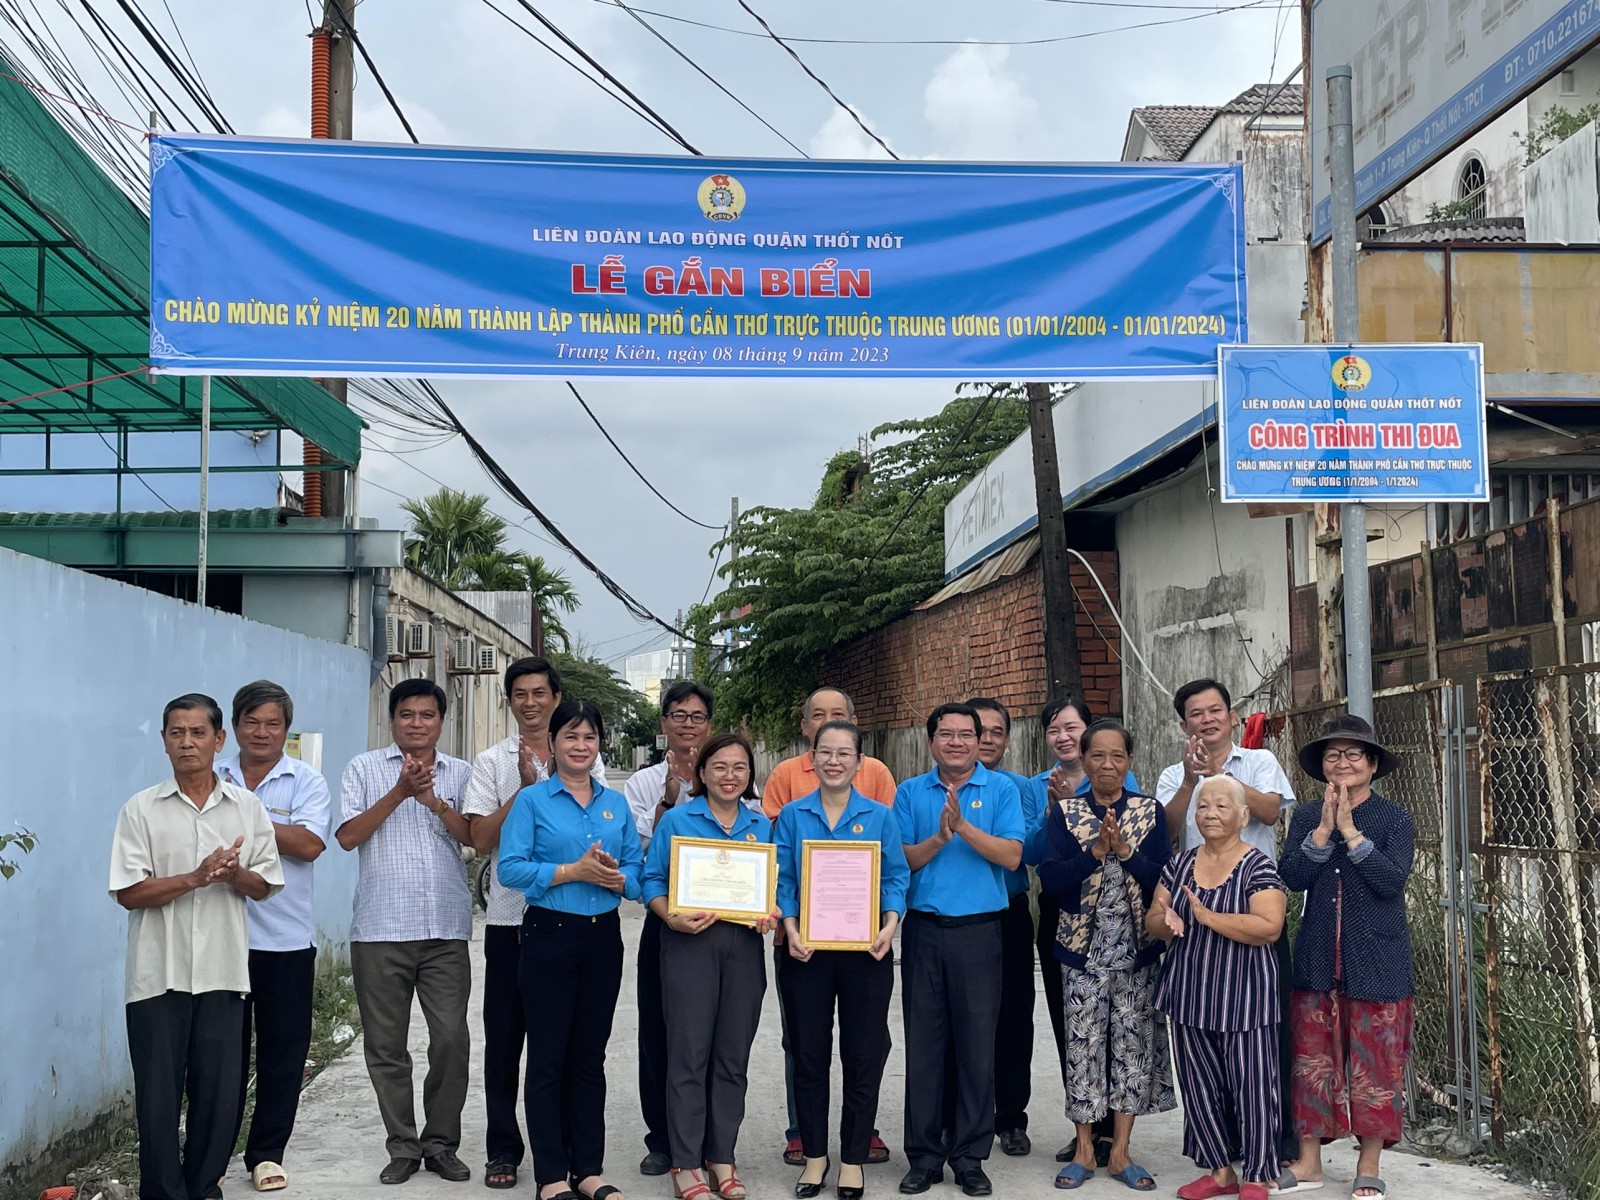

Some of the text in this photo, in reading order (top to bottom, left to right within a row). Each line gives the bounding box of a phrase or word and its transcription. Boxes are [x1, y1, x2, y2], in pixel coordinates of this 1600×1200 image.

[1504, 56, 1525, 84] ĐT:
[533, 226, 904, 250] LIÊN ĐOÀN LAO ĐỘNG QUẬN THỐT NỐT
[571, 254, 872, 298] LỄ GẮN BIỂN
[164, 296, 221, 324] CHÀO
[227, 298, 289, 326] MỪNG
[295, 297, 321, 326] KỶ
[327, 301, 380, 332] NIỆM
[386, 306, 410, 328] 20
[416, 303, 462, 329] NĂM
[468, 306, 532, 331] THÀNH
[537, 307, 573, 337] LẬP
[578, 308, 641, 335] THÀNH
[647, 306, 685, 335] PHỐ
[690, 307, 728, 336] CẦN
[734, 312, 768, 336] THƠ
[774, 312, 819, 341] TRỰC
[825, 311, 883, 341] THUỘC
[888, 315, 946, 337] TRUNG
[952, 314, 1000, 337] ƯƠNG
[1006, 314, 1107, 339] (01/01/2004
[1123, 314, 1226, 338] 01/01/2024)
[555, 342, 889, 366] Trung Kiên, ngày 08 tháng 9 năm 2023
[1242, 395, 1463, 412] LIÊN ĐOÀN LAO ĐỘNG QUẬN THỐT NỐT
[1249, 419, 1460, 449] CÔNG TRÌNH THI ĐUA
[1236, 458, 1257, 471] CHÀO
[1259, 457, 1282, 471] MỪNG
[1295, 458, 1316, 473] NIỆM
[1317, 460, 1327, 470] 20
[1328, 457, 1347, 470] NĂM
[1349, 458, 1374, 470] THÀNH
[1375, 456, 1391, 470] PHỐ
[1410, 458, 1425, 470] THƠ
[1426, 458, 1446, 472] TRỰC
[1448, 457, 1472, 472] THUỘC
[1292, 476, 1317, 487] TRUNG
[1318, 475, 1341, 487] ƯƠNG
